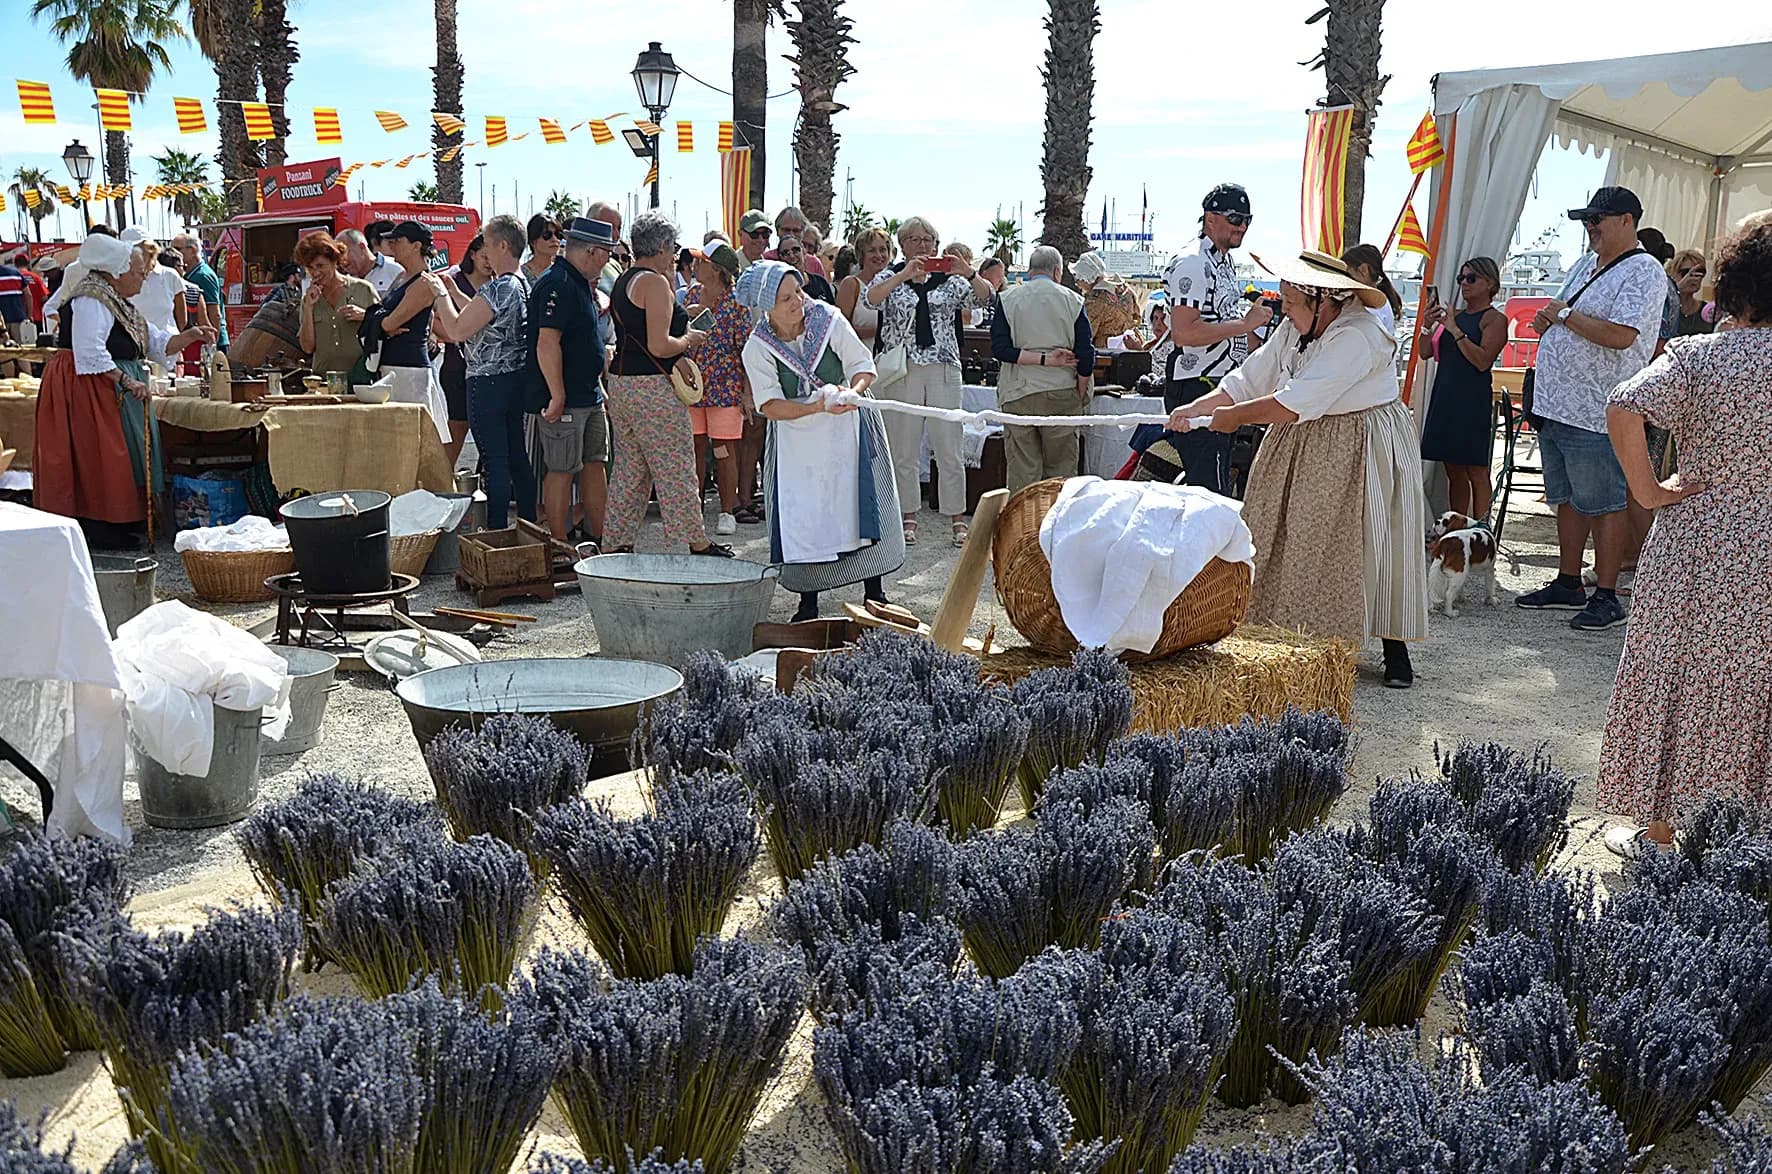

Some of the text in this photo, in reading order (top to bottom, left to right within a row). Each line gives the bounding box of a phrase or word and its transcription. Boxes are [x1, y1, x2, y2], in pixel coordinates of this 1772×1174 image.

[285, 169, 312, 182] Panzani
[281, 183, 323, 200] FOODTRUCK
[374, 211, 388, 220] Des
[389, 211, 409, 221] pâtes
[418, 213, 430, 222] des
[1090, 233, 1153, 241] GARE MARITIME
